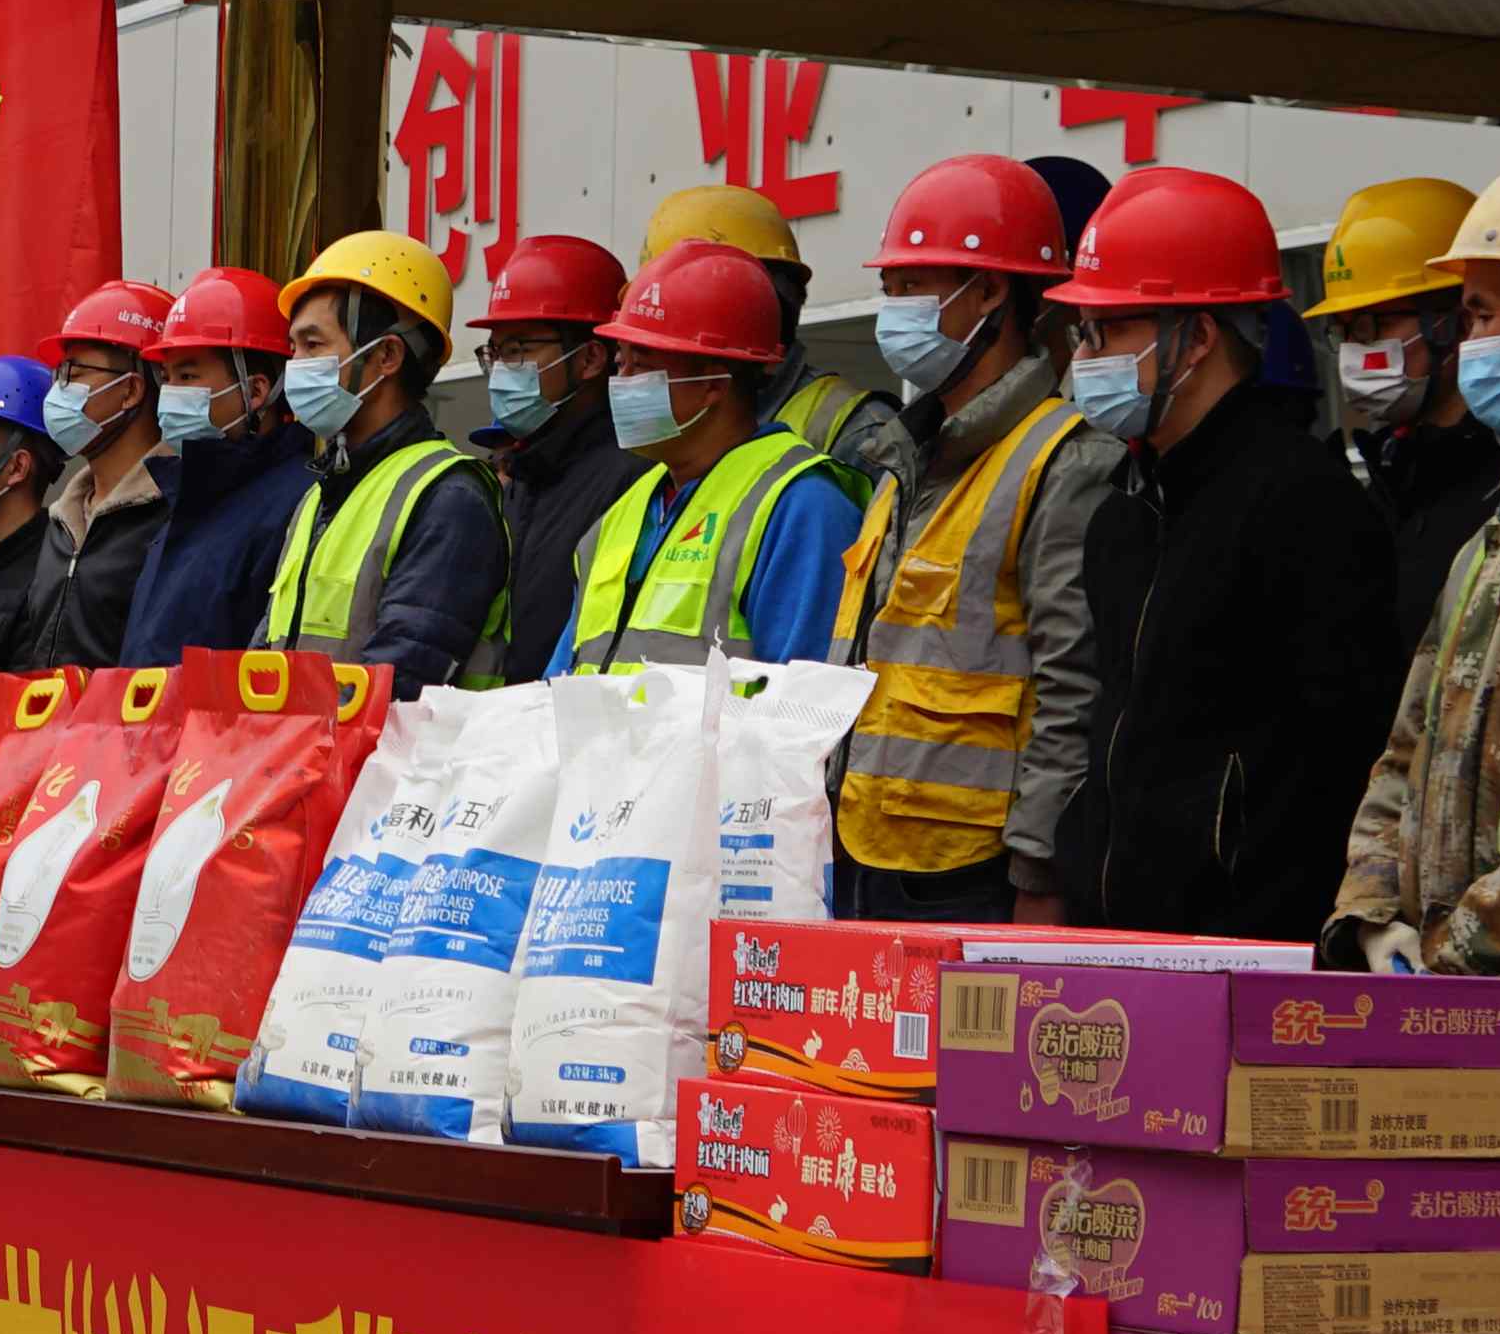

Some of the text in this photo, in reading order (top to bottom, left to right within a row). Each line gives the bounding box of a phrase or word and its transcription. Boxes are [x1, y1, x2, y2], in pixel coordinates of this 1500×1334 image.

[732, 978, 806, 1014] 红烧牛肉面
[810, 969, 895, 1030] 新年康是福
[1036, 1018, 1125, 1061] 老坛酸菜
[1271, 997, 1372, 1046] 统一
[1058, 1059, 1099, 1084] 牛肉面
[696, 1140, 770, 1178] 红烧牛肉面
[801, 1138, 897, 1203] 新年康是福
[1048, 1197, 1141, 1241] 老坛酸菜
[1284, 1185, 1382, 1232] 统一
